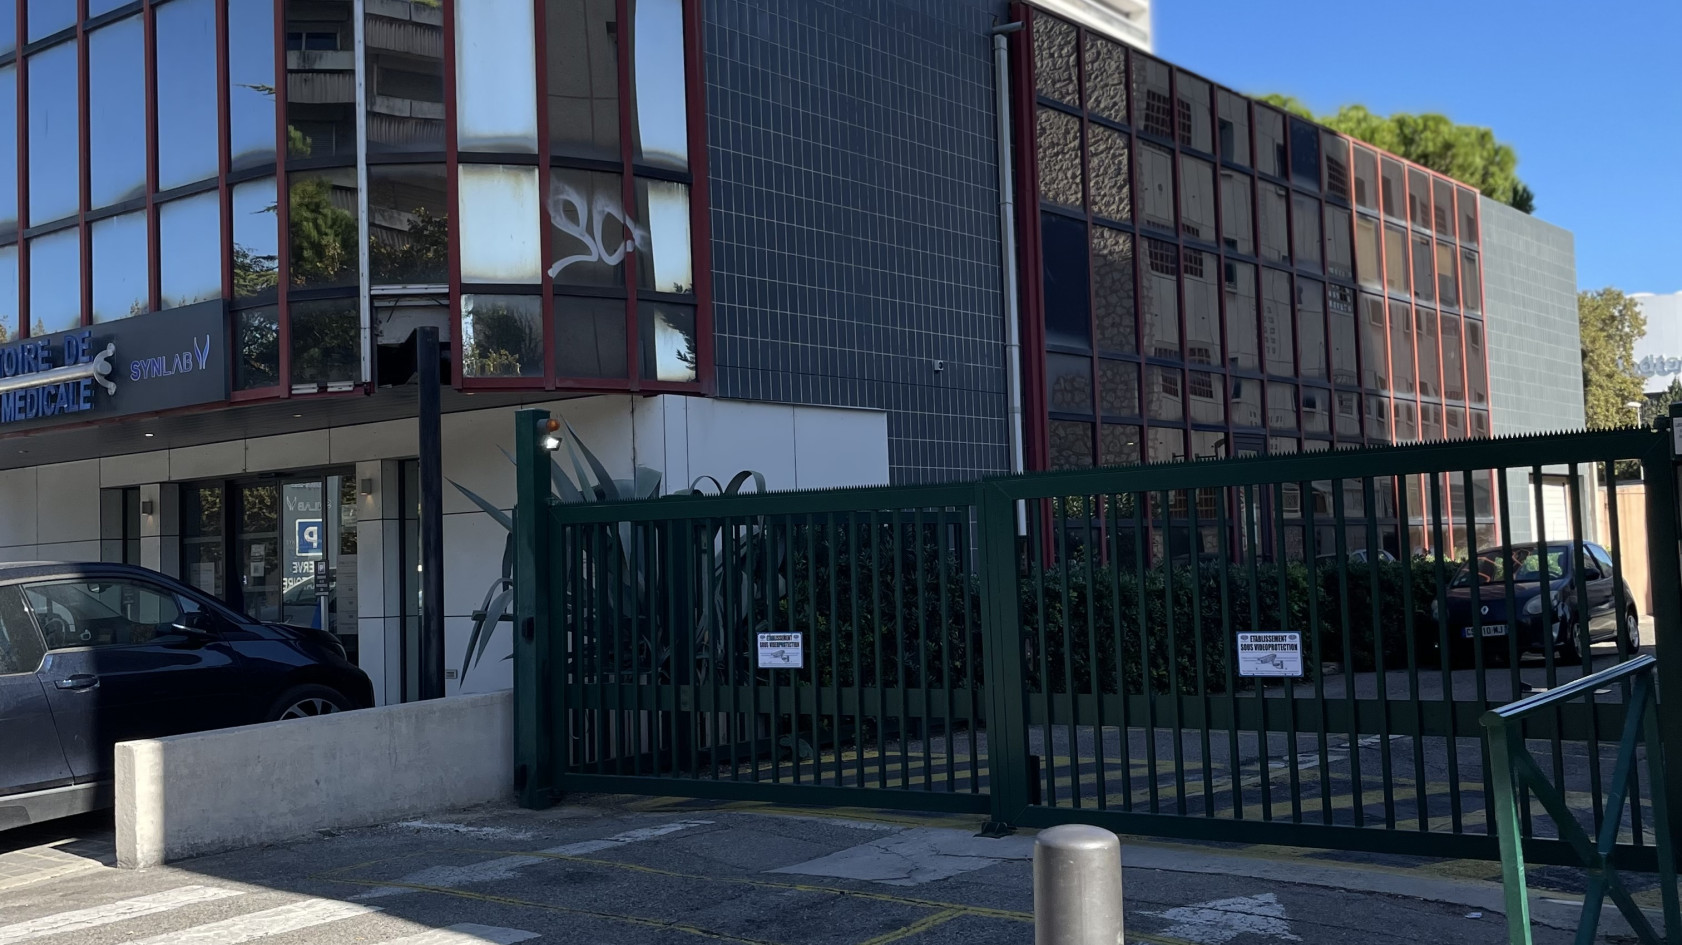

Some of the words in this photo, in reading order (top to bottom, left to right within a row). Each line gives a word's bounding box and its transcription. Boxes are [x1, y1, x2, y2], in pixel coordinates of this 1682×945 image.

[0, 339, 51, 377] OIRE
[64, 330, 93, 365] DE
[130, 351, 193, 381] SYNLAB
[1, 378, 94, 423] MEDICALE
